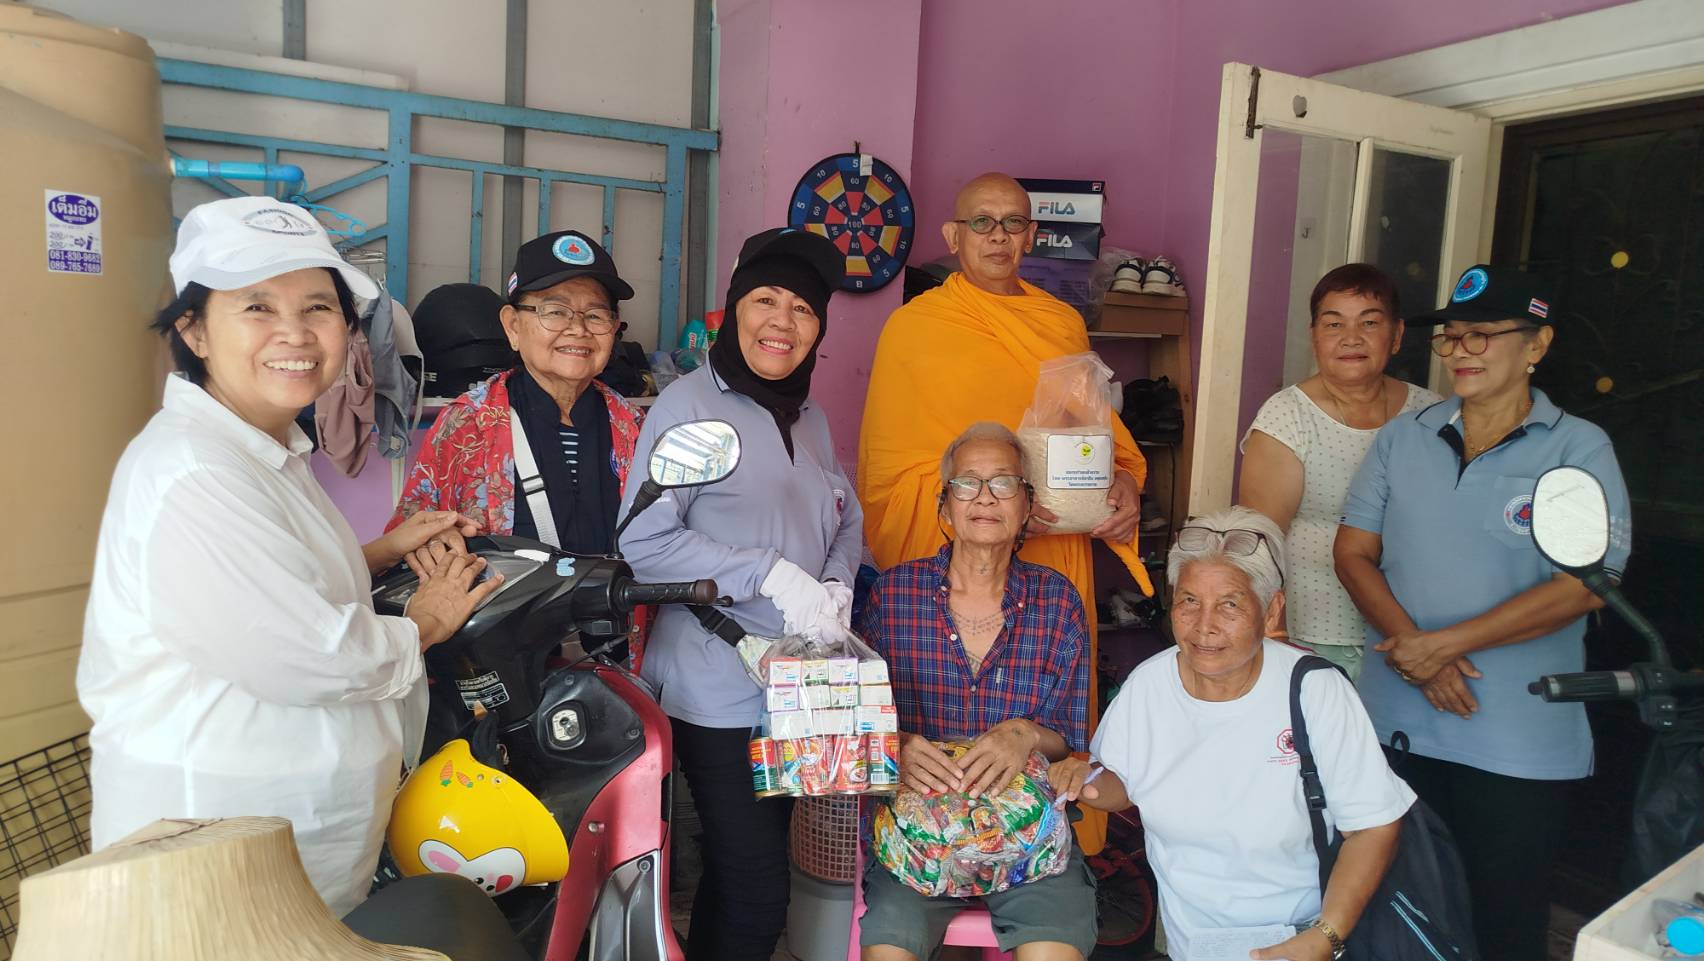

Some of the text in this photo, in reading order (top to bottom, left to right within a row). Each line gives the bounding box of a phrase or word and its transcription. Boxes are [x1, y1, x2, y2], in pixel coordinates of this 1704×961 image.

[852, 159, 859, 168] 5
[816, 169, 826, 179] 10
[1038, 201, 1076, 215] FILA
[1036, 233, 1072, 248] FILA
